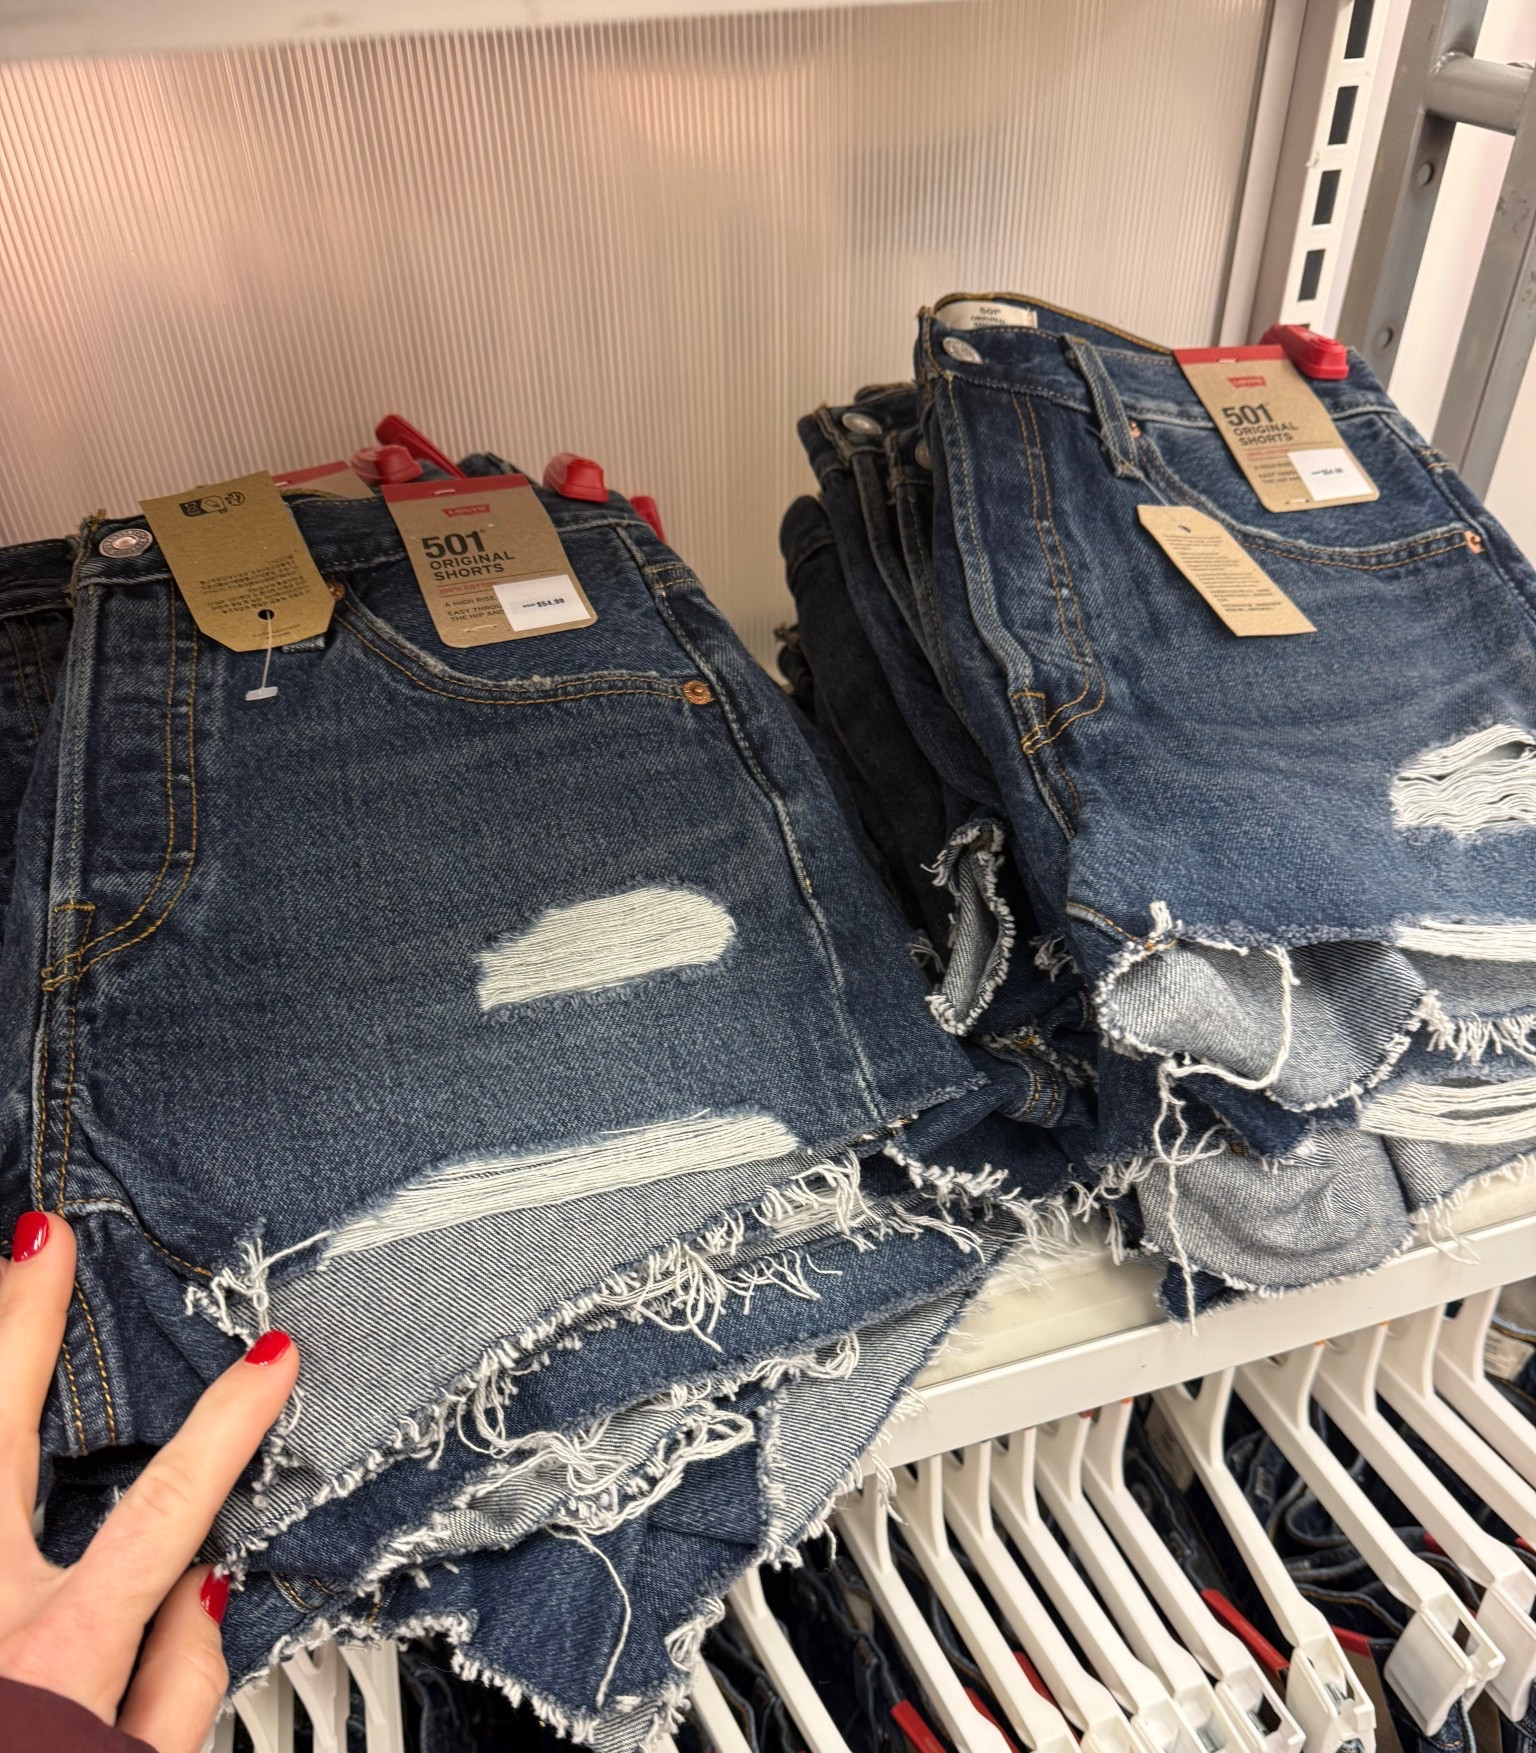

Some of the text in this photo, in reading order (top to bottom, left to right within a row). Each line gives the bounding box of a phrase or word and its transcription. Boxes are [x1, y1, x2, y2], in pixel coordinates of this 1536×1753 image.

[1222, 403, 1274, 427] 501
[1233, 421, 1299, 437] ORIGINAL
[1238, 432, 1293, 446] SHORTS
[421, 530, 485, 559] 501
[430, 551, 515, 571] ORIGINAL
[434, 563, 504, 581] SHORTS
[536, 598, 565, 608] $54.99
[447, 608, 470, 616] EASY
